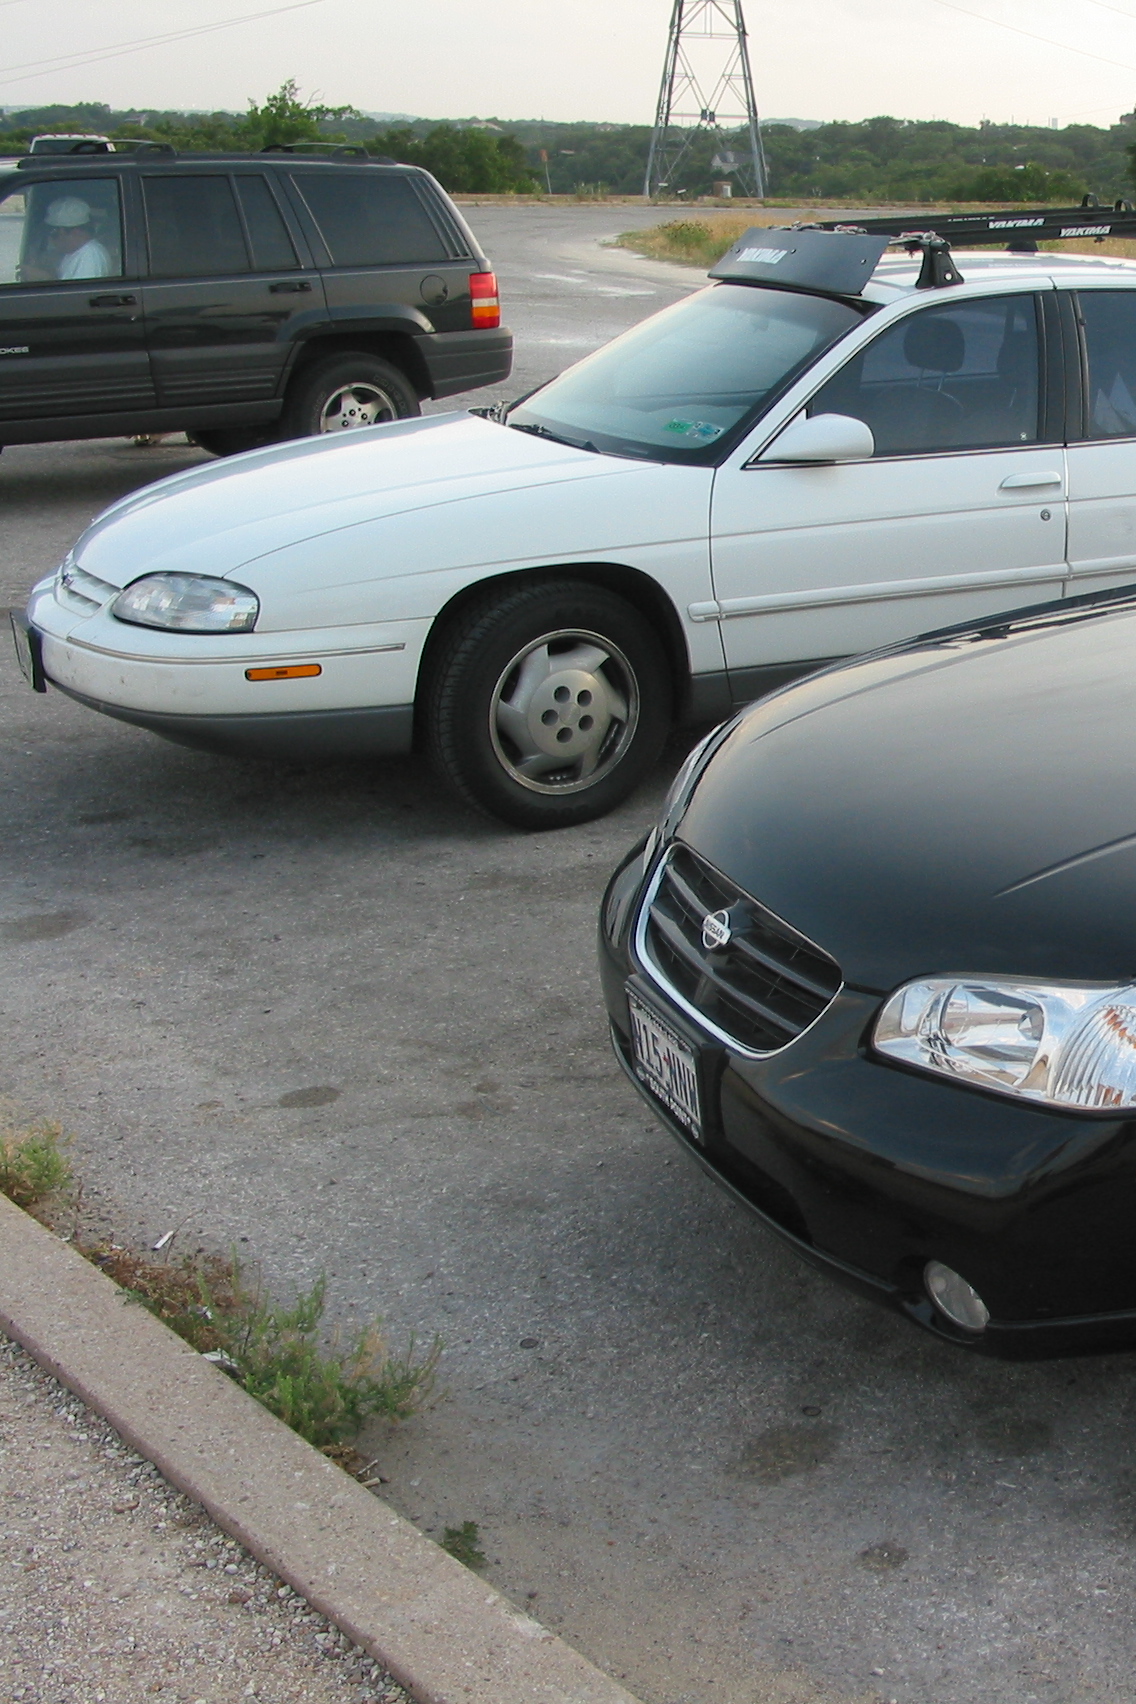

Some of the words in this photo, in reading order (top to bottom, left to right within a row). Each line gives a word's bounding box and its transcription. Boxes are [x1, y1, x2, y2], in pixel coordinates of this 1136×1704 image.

[988, 217, 1045, 229] YAKIMA
[1060, 225, 1112, 238] YAKIMA
[703, 917, 725, 940] NISSAN
